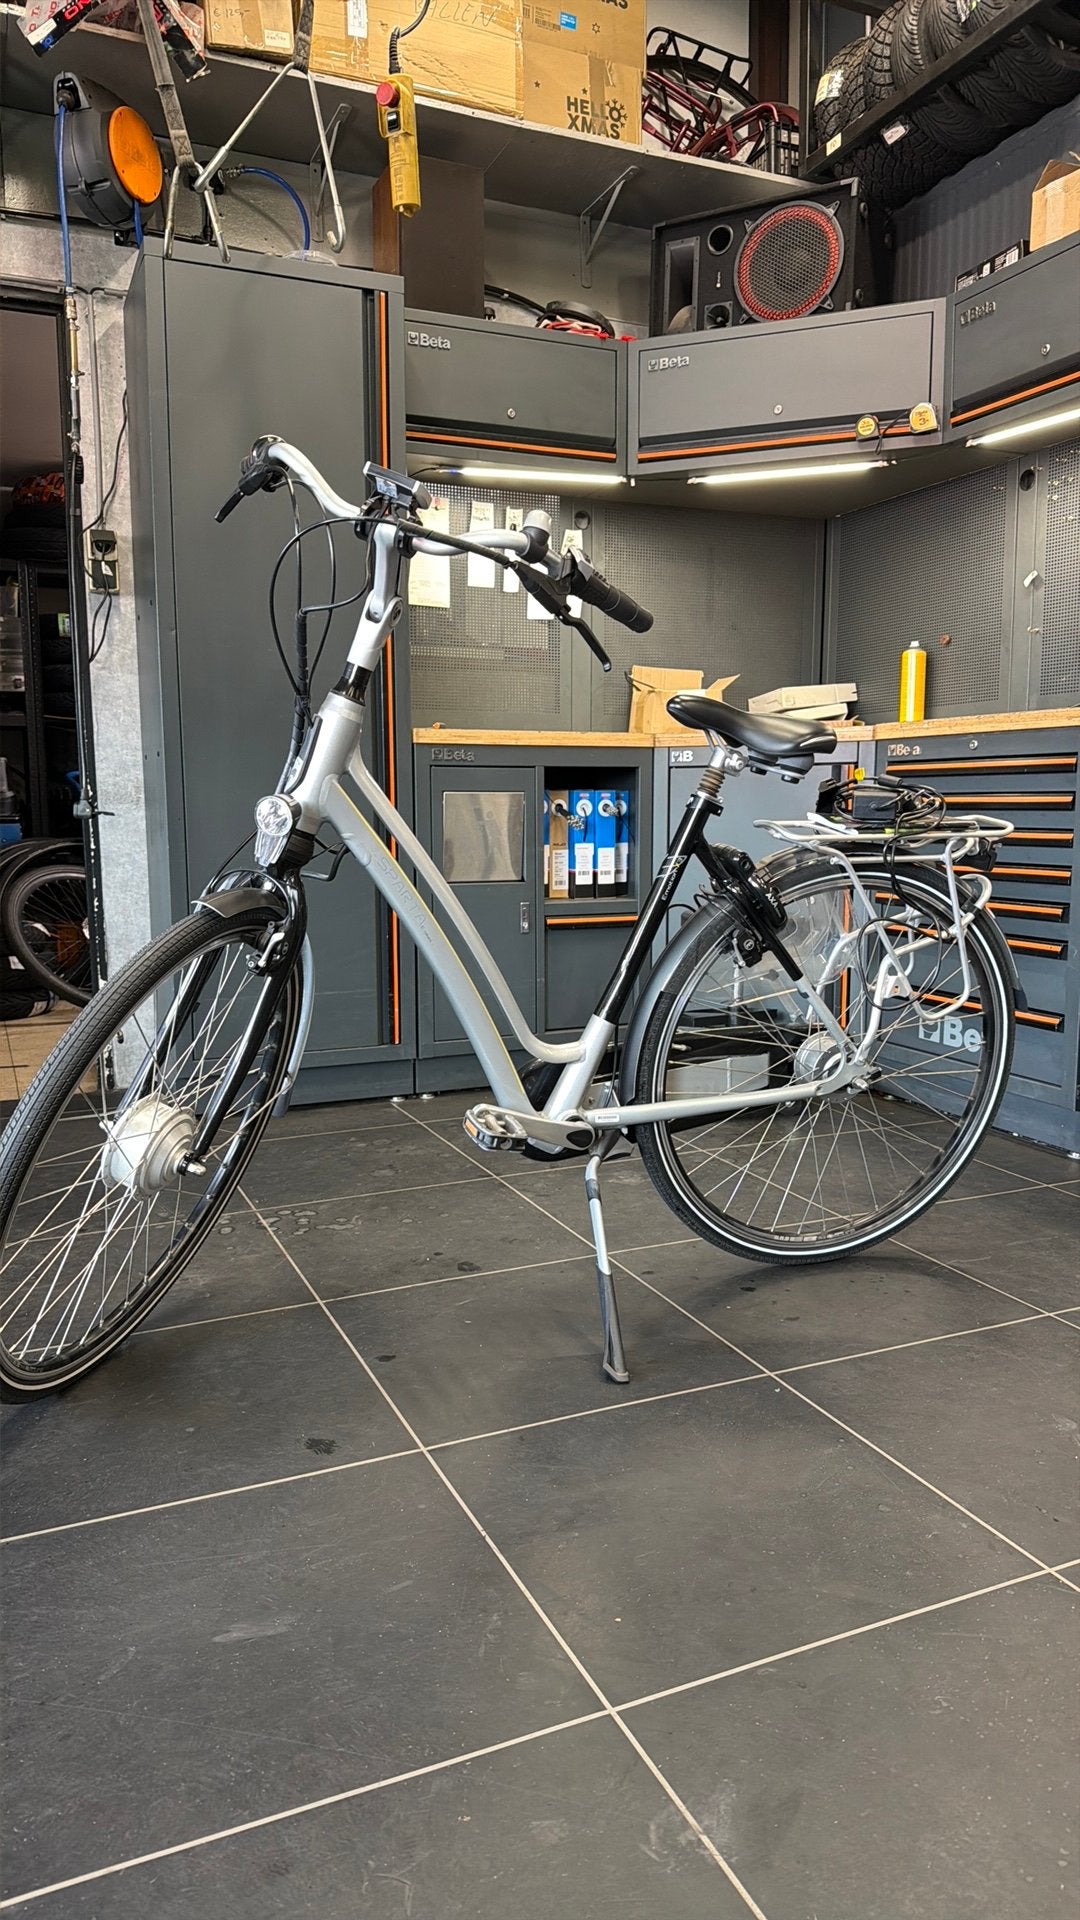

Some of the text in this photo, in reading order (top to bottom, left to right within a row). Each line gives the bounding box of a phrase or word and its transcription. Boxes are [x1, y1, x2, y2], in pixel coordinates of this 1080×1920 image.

[566, 95, 621, 123] HELLO
[567, 112, 621, 140] XMAS
[420, 332, 451, 349] Beta
[659, 355, 690, 370] Beta
[443, 748, 475, 761] Beta
[896, 743, 921, 756] Bea
[764, 892, 779, 909] AXA
[943, 1015, 982, 1053] Be
